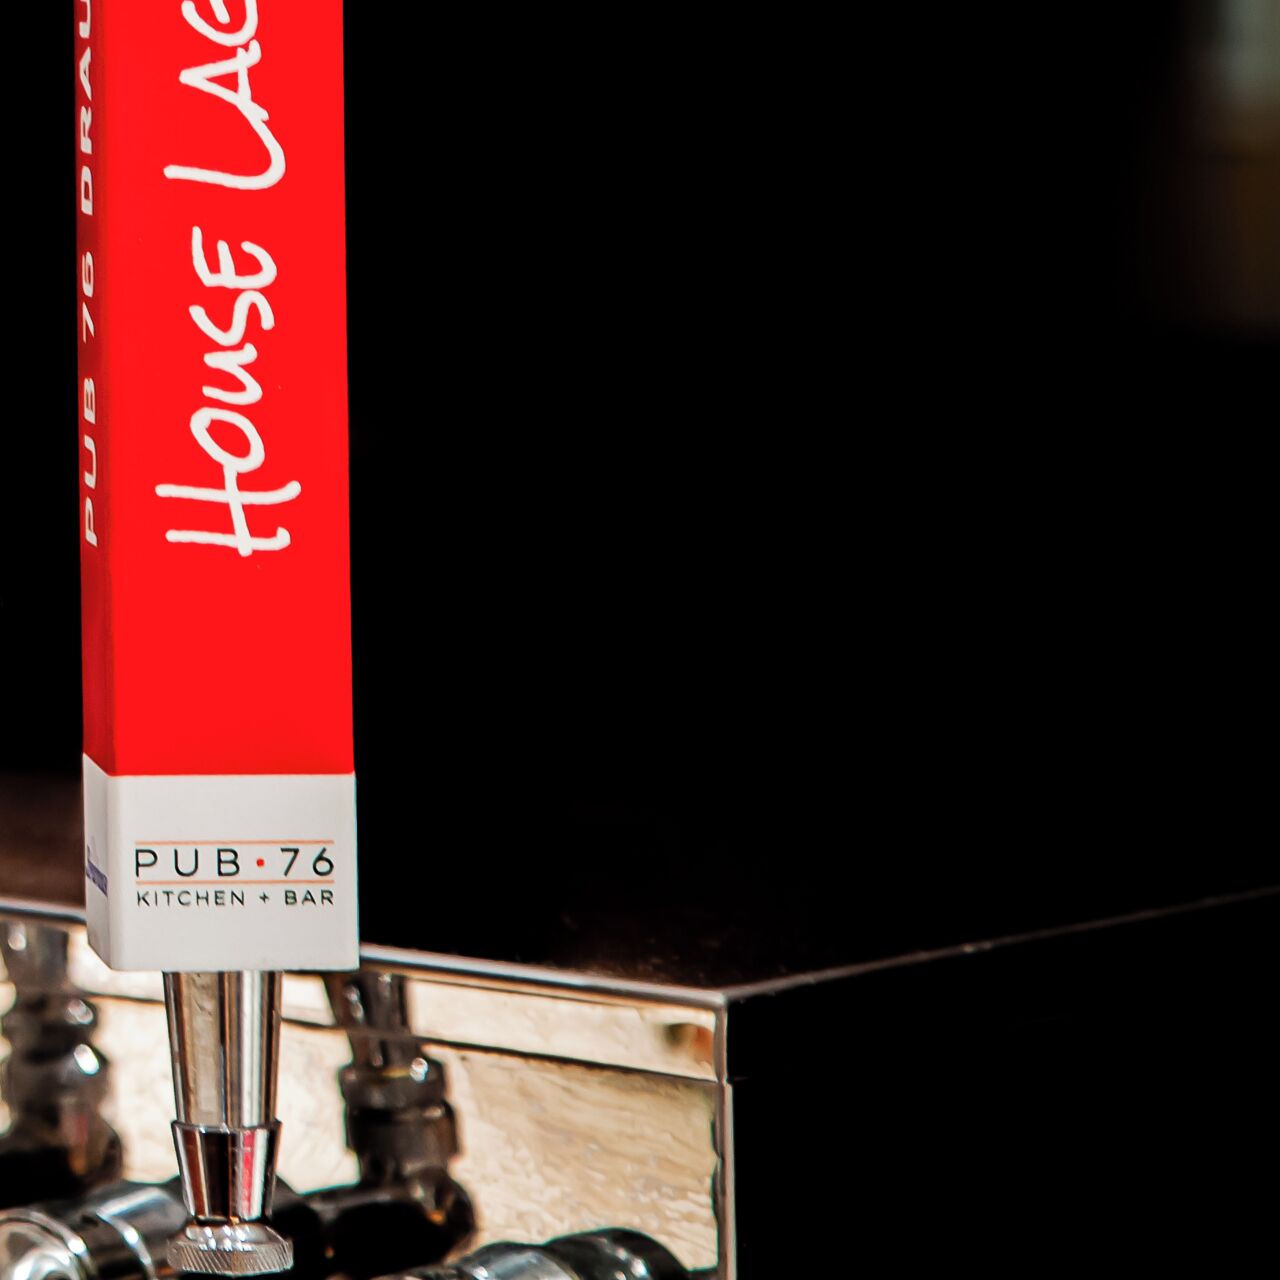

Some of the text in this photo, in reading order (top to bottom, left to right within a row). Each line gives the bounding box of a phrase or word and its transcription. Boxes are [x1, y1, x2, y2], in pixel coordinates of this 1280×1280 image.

[82, 251, 95, 345] 76
[84, 376, 98, 548] PUB
[134, 847, 241, 878] PUB
[279, 846, 335, 878] 76
[136, 889, 246, 908] KITCHEN
[283, 888, 335, 906] BAR
